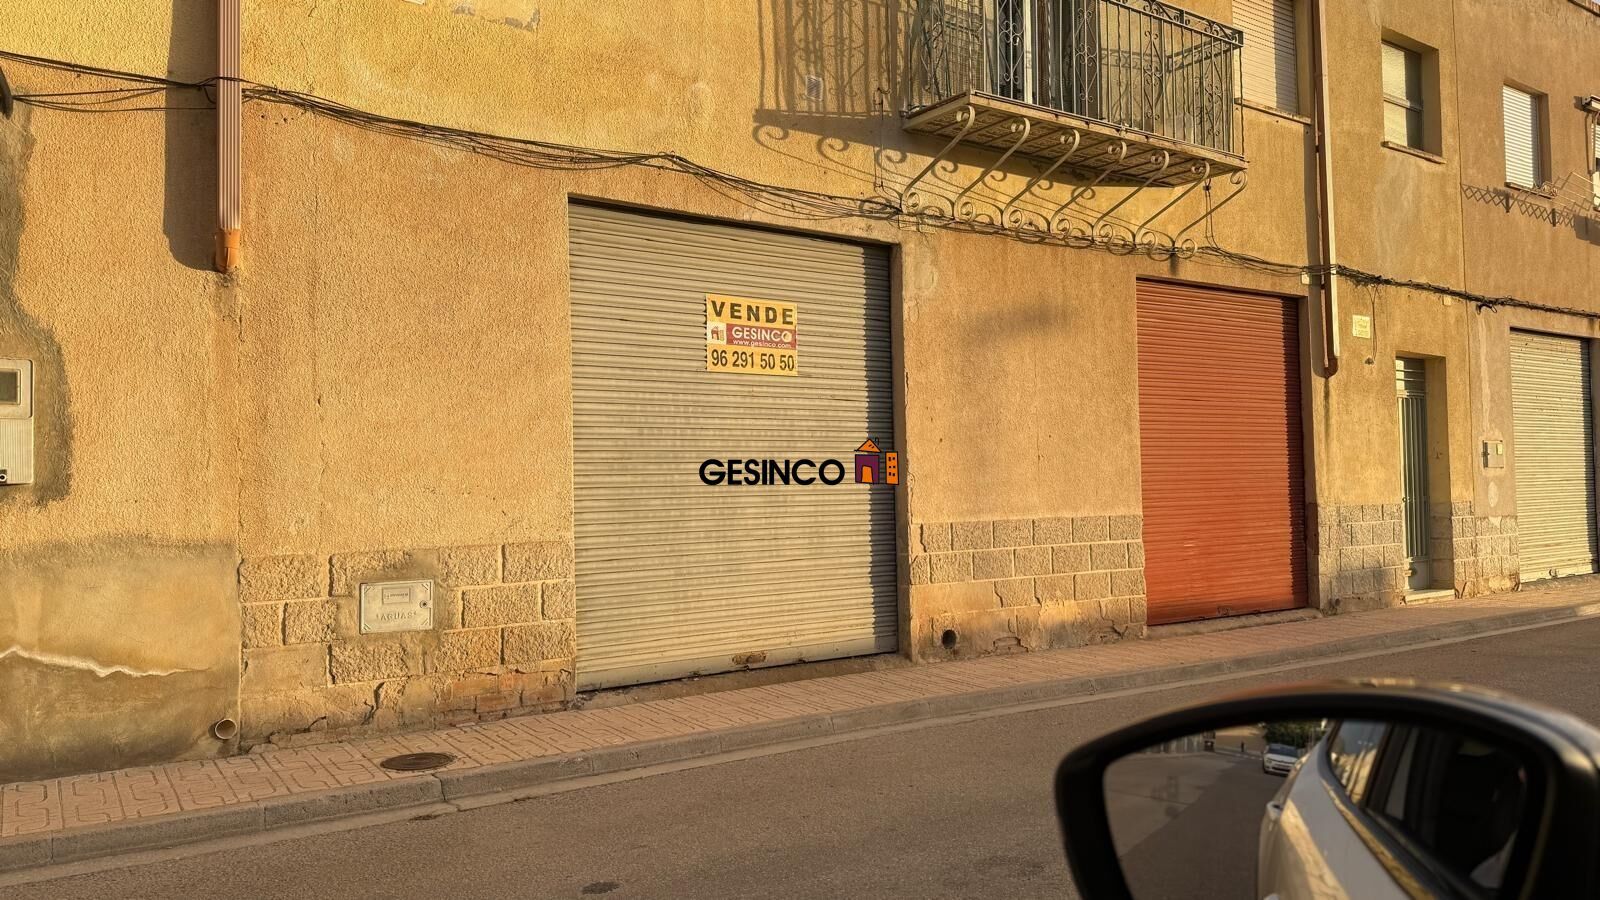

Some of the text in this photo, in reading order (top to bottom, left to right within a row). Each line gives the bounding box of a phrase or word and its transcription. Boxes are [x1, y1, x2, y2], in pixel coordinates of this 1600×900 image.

[711, 300, 793, 325] VENDE
[732, 326, 792, 343] GESINCO
[733, 339, 792, 349] www.gesinco.com
[711, 349, 795, 371] 96 291 50 50
